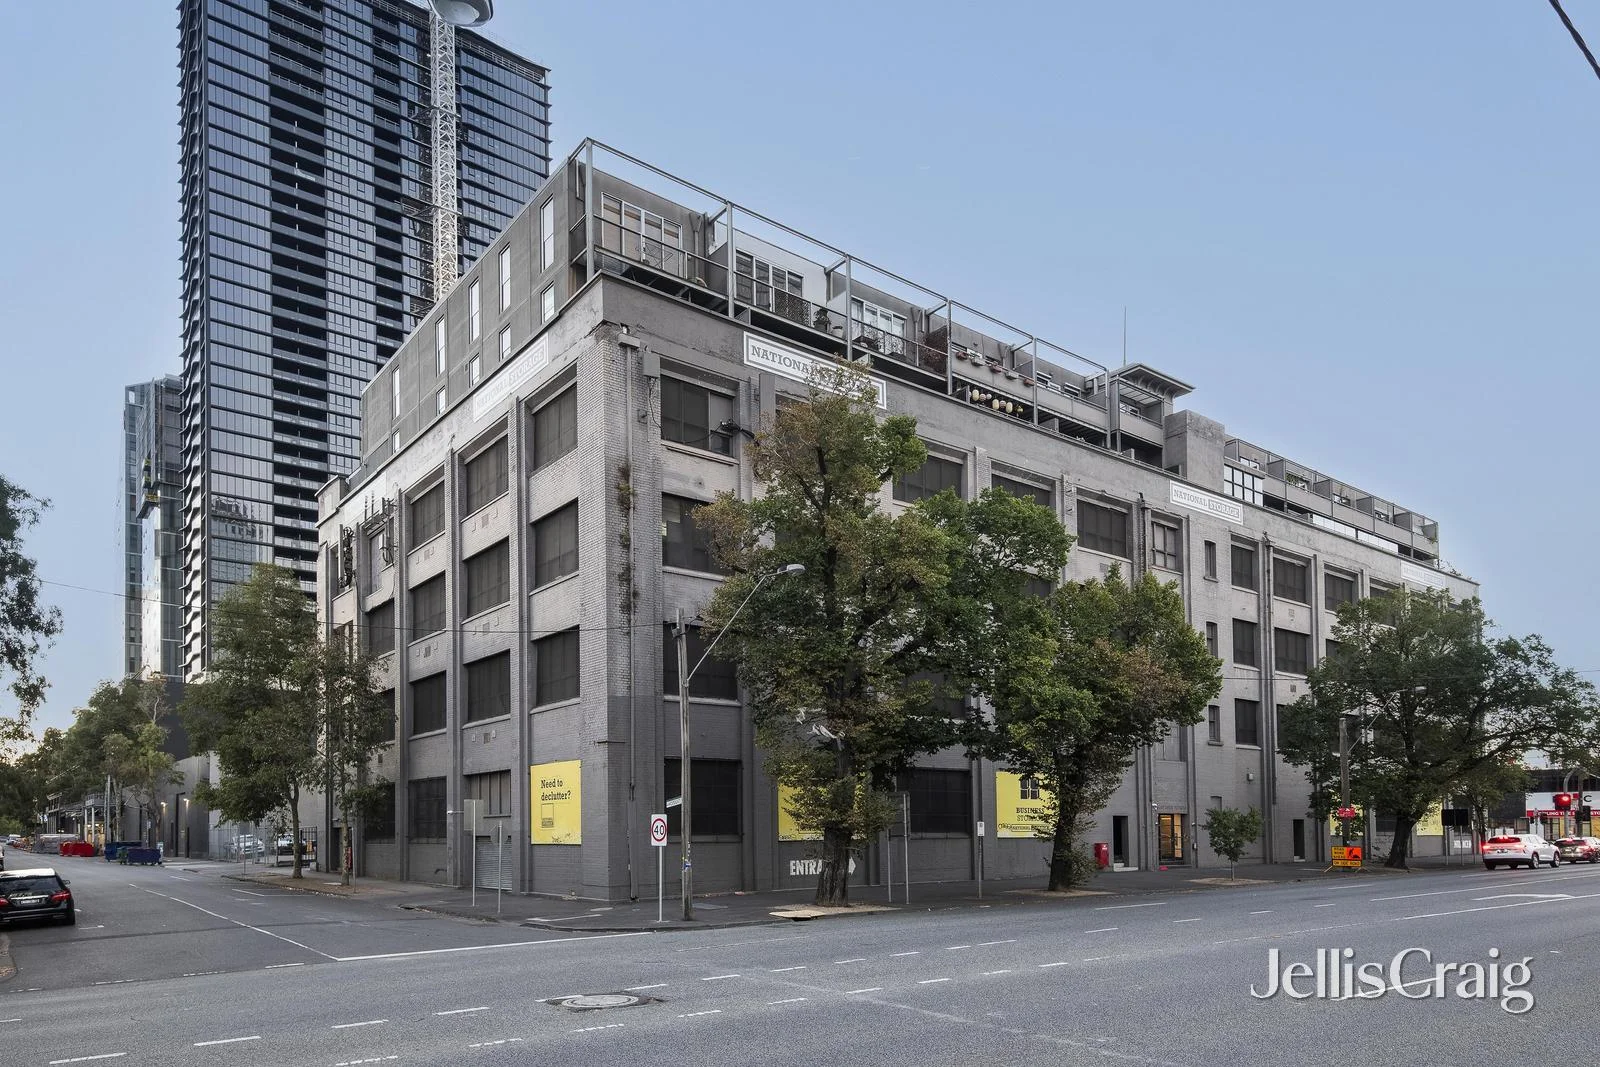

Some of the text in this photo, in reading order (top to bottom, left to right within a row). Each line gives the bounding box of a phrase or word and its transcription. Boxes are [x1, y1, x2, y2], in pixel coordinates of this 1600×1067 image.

[751, 344, 820, 377] NATIONA
[1173, 487, 1239, 517] NATIONAL STORAGE
[541, 779, 564, 789] Need to
[541, 790, 571, 801] declutter?
[1016, 807, 1045, 815] BUSINESS
[654, 824, 665, 836] 40
[789, 860, 823, 875] ENTRA
